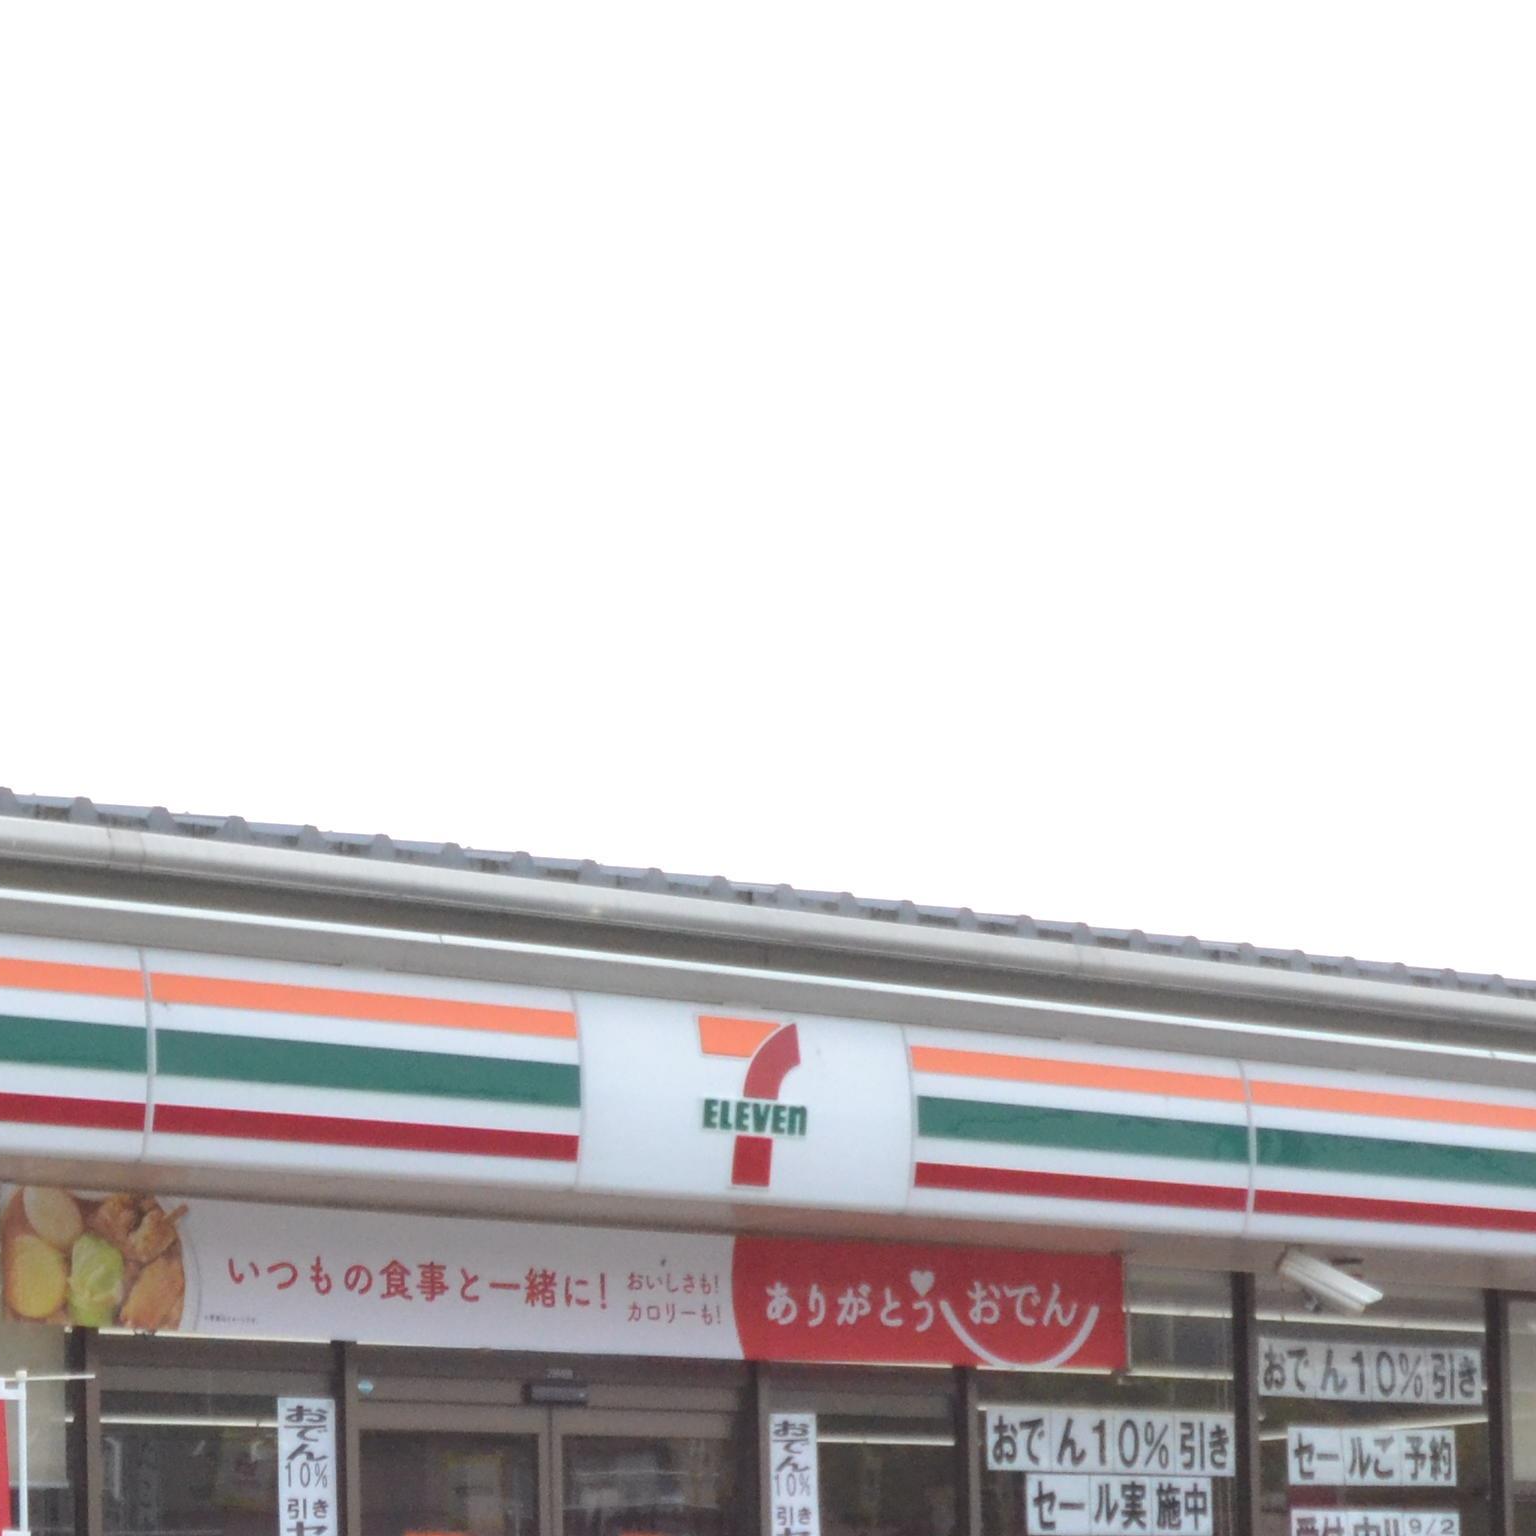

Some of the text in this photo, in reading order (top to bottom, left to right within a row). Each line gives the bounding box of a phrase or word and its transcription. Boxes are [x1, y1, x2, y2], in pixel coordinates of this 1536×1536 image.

[766, 1282, 935, 1332] ありがとう
[967, 1281, 1078, 1328] おでん
[1263, 1345, 1478, 1402] おでん10%引き
[992, 1415, 1231, 1471] おでん10%引き
[1293, 1435, 1453, 1481] セールご予約
[1032, 1482, 1209, 1532] セール実施中
